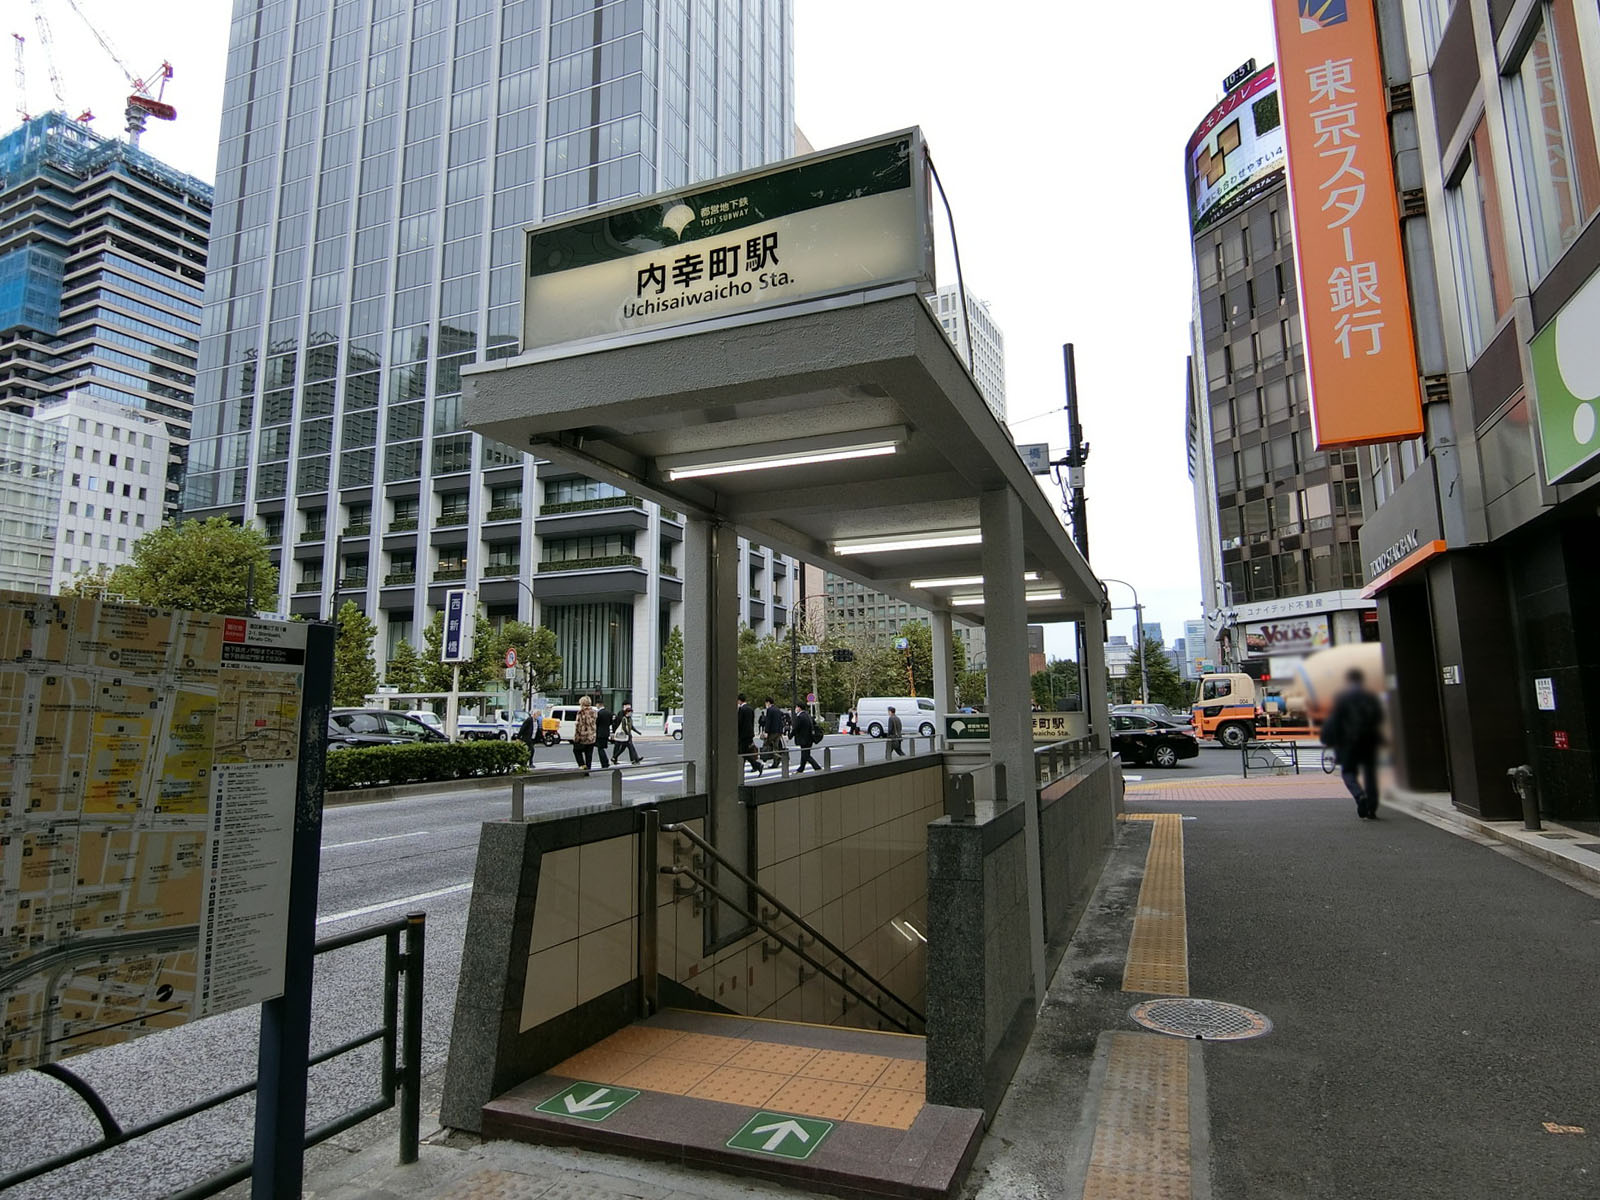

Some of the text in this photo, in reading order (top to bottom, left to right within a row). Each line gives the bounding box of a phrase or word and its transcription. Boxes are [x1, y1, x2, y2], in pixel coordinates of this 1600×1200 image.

[1225, 61, 1251, 88] 10:51
[700, 196, 749, 218] 都営地下鉄
[700, 208, 749, 227] TOEI SUBWAY
[1305, 57, 1385, 359] 東京スター銀行
[636, 231, 779, 297] 内幸町駅
[623, 272, 795, 320] Uchisaiwaicho Sta.
[1386, 542, 1401, 566] STAR
[1400, 528, 1419, 556] BANK
[1247, 599, 1323, 616] ユナイテッド不動産
[447, 598, 461, 653] 西新橋
[1260, 624, 1312, 645] VOLKS
